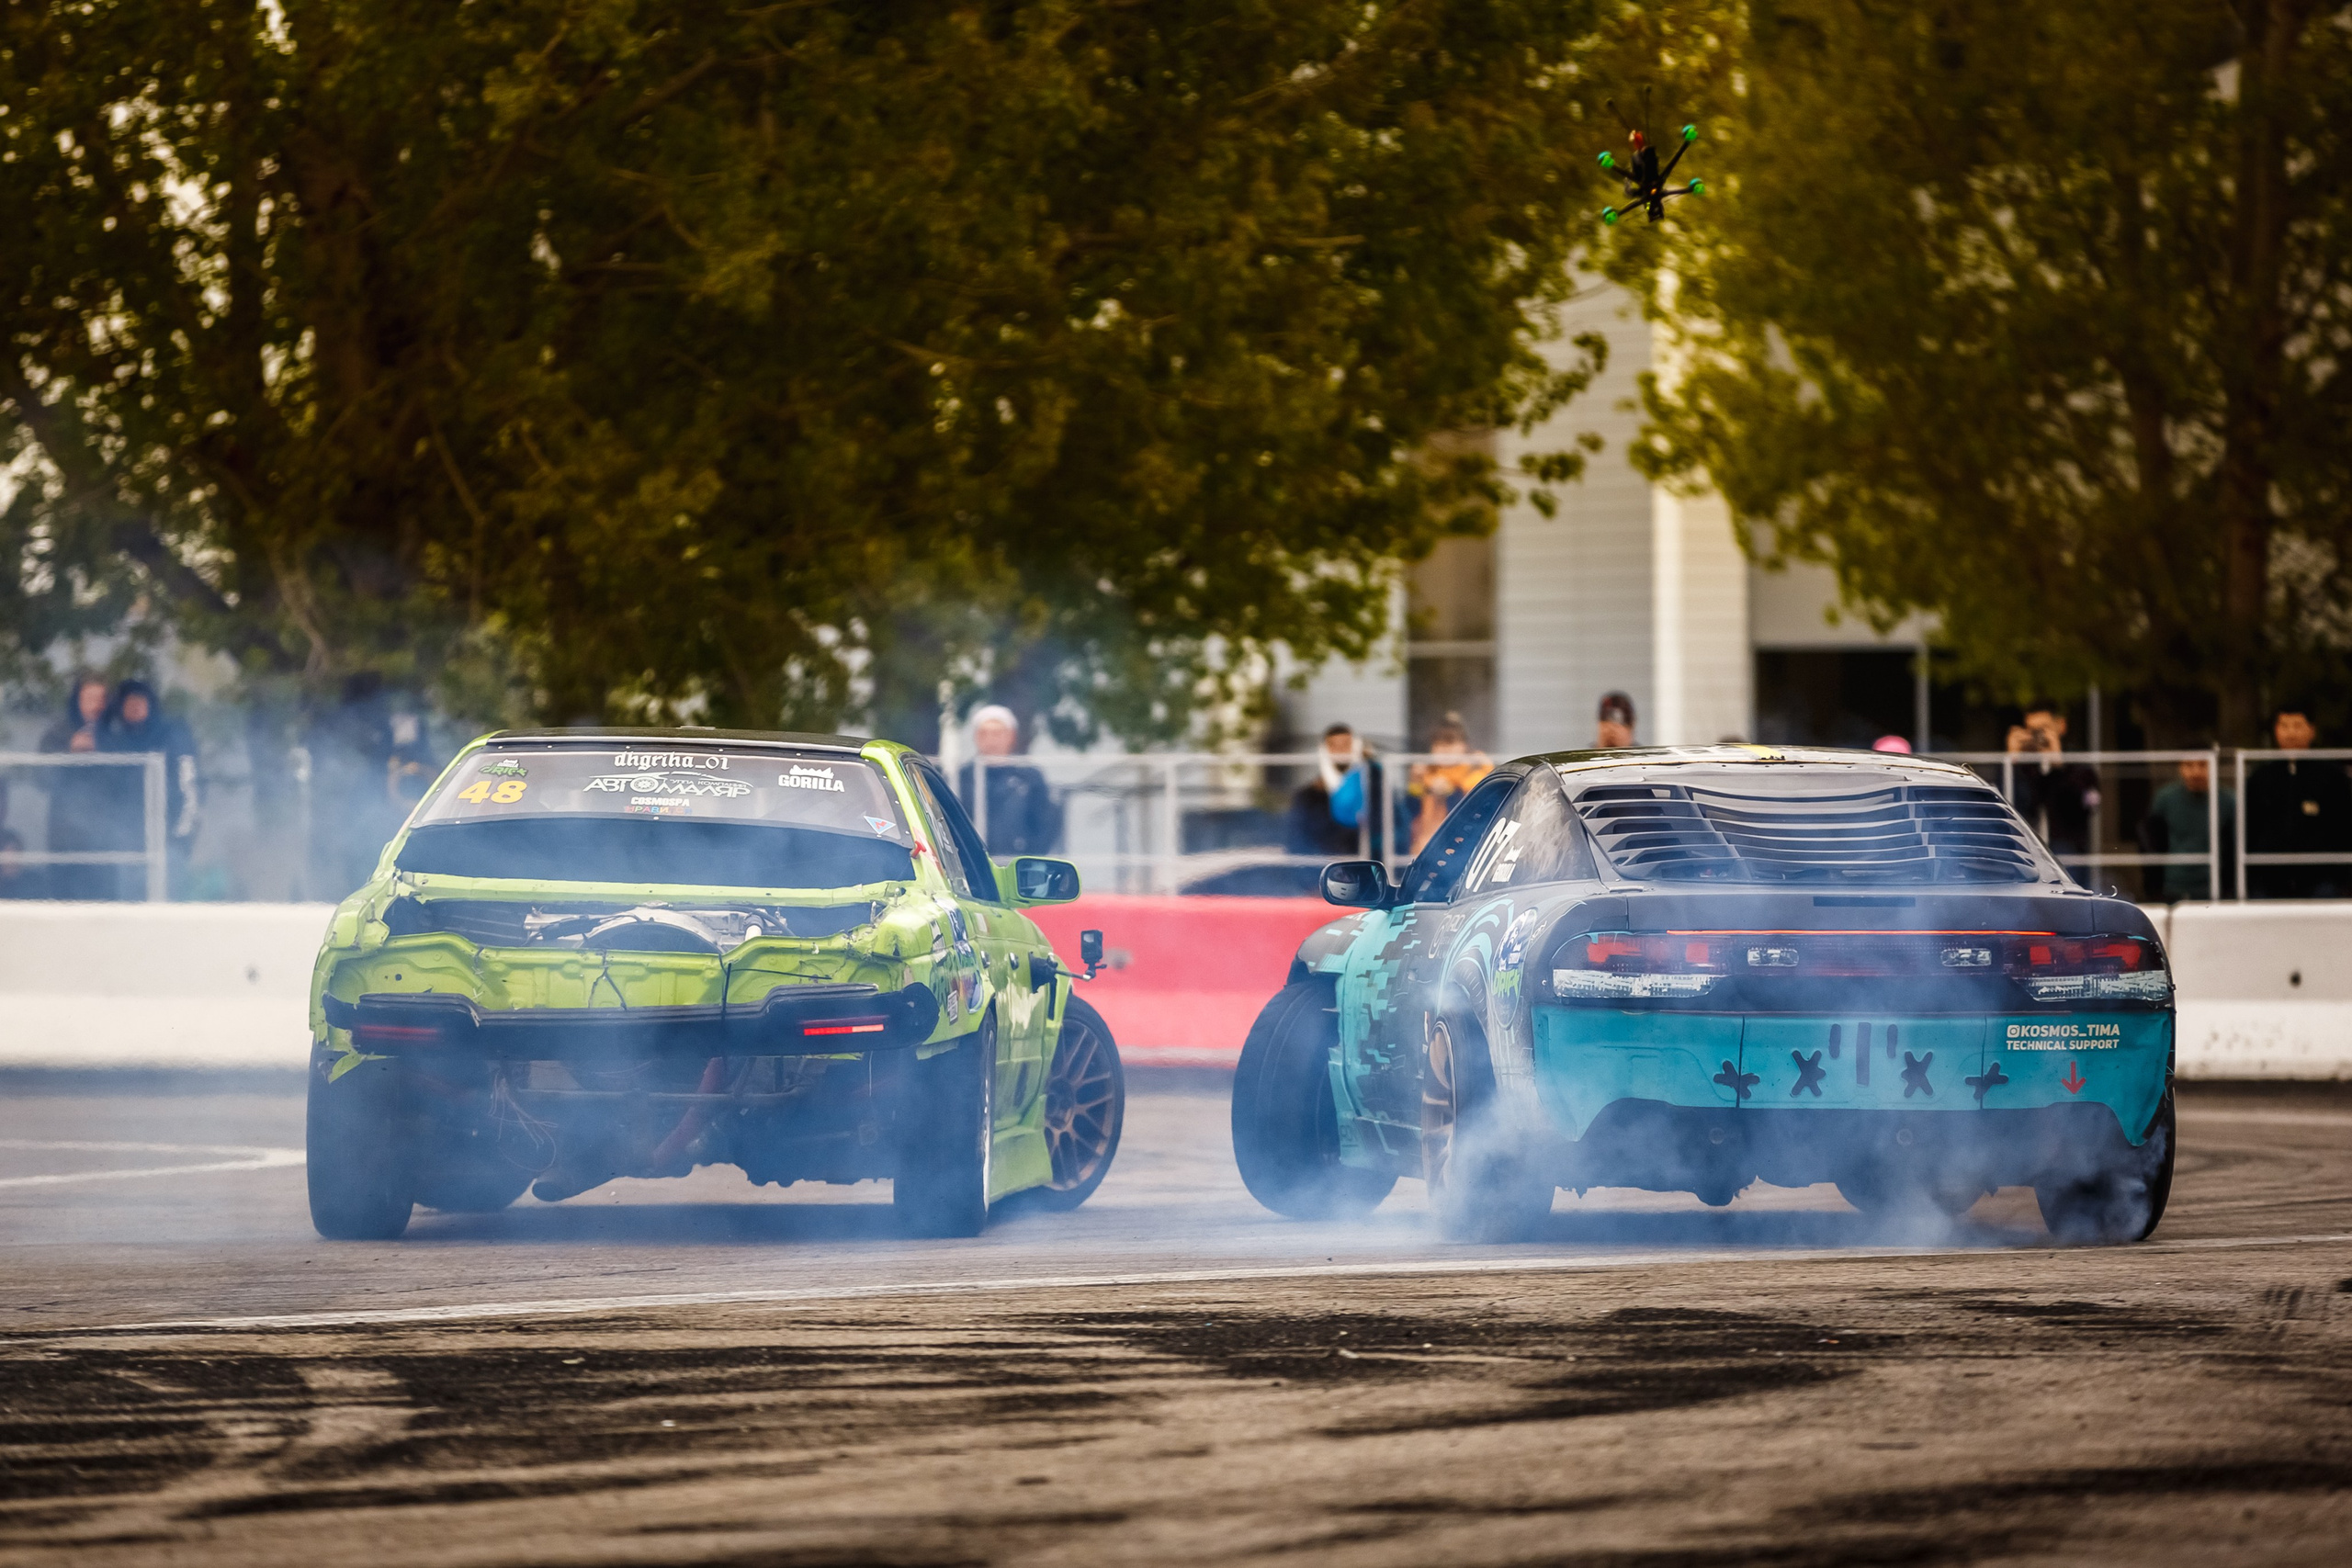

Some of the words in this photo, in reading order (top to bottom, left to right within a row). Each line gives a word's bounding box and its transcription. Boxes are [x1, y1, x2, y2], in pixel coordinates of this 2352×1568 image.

[458, 780, 527, 804] 48
[778, 774, 845, 793] GORILLA
[630, 795, 691, 807] COSMOSPA
[1464, 817, 1522, 893] 07
[2007, 1040, 2067, 1051] TECHNICAL
[2069, 1039, 2120, 1050] SUPPORT
